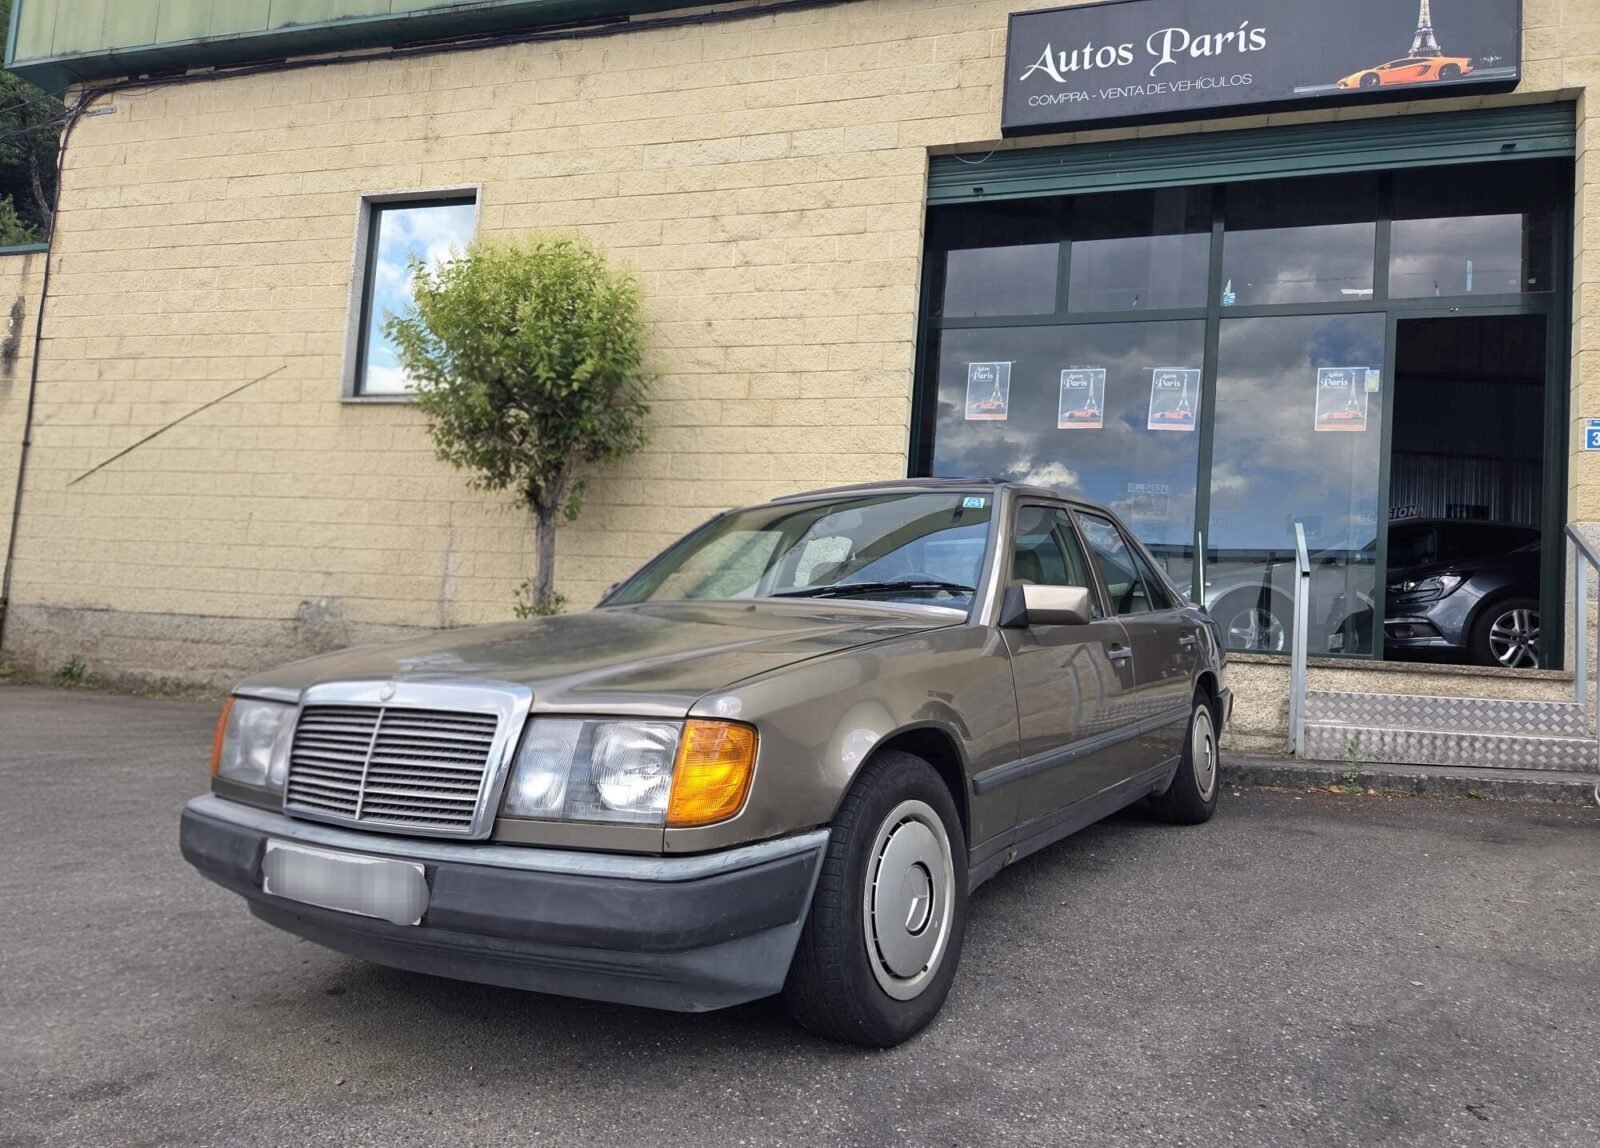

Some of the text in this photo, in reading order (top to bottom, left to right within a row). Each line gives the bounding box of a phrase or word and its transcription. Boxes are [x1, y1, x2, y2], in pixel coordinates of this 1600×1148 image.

[1019, 20, 1266, 83] Autos París
[1028, 91, 1090, 106] COMPRA
[1099, 84, 1144, 99] VENTA
[1146, 82, 1168, 95] DE
[1169, 73, 1253, 92] VEHÍCULOS
